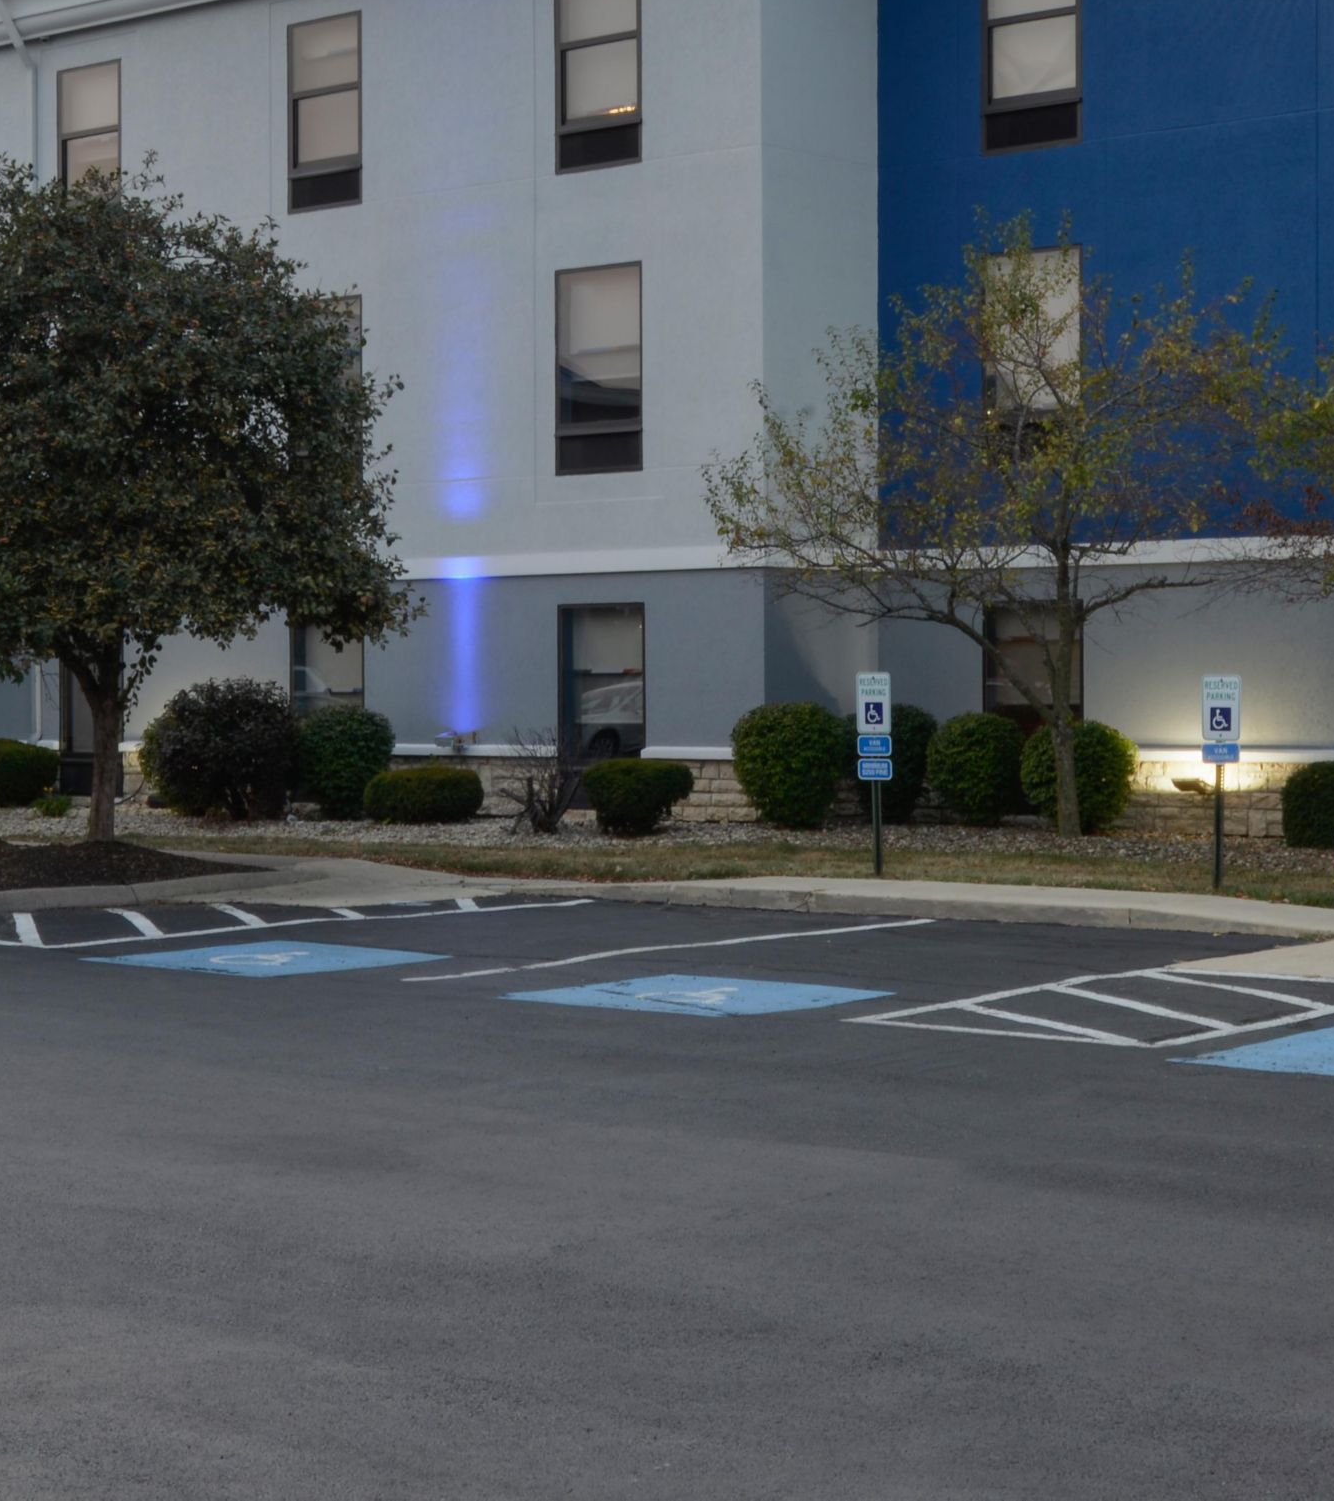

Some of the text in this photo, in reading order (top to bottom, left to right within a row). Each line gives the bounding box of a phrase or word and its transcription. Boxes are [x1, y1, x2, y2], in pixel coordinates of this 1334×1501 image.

[859, 678, 888, 686] RESERVED
[1204, 681, 1238, 690] RESERVED
[860, 688, 887, 696] PARKING
[1207, 691, 1236, 701] PARKING
